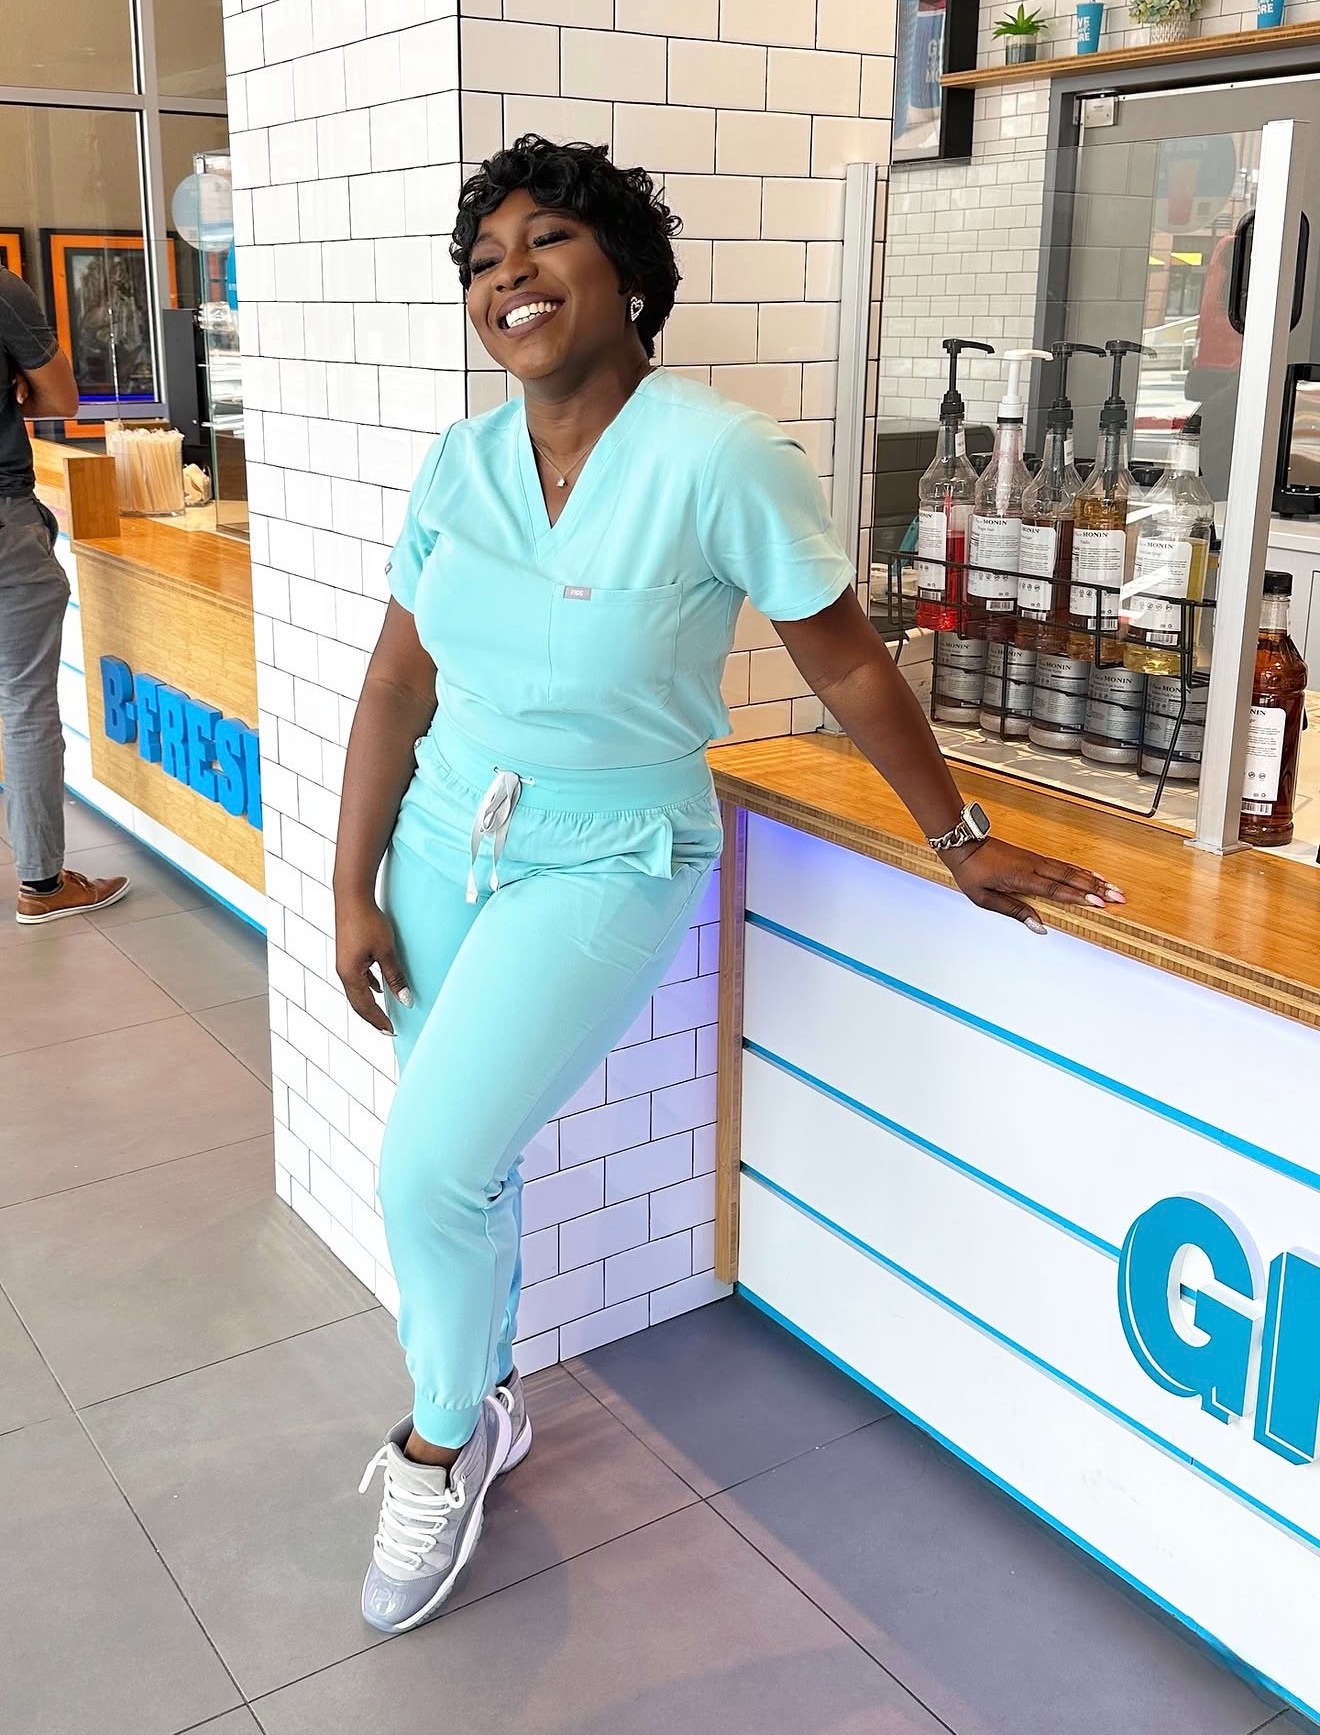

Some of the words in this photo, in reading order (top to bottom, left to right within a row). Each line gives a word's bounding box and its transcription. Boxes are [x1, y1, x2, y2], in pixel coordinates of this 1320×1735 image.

[1147, 541, 1174, 549] MONIN
[945, 642, 969, 650] MONIN
[998, 649, 1022, 657] MNIN
[1046, 661, 1072, 670] MONIN
[1104, 675, 1133, 684] MONIN
[1162, 685, 1192, 695] MONN
[1250, 708, 1267, 716] NIN
